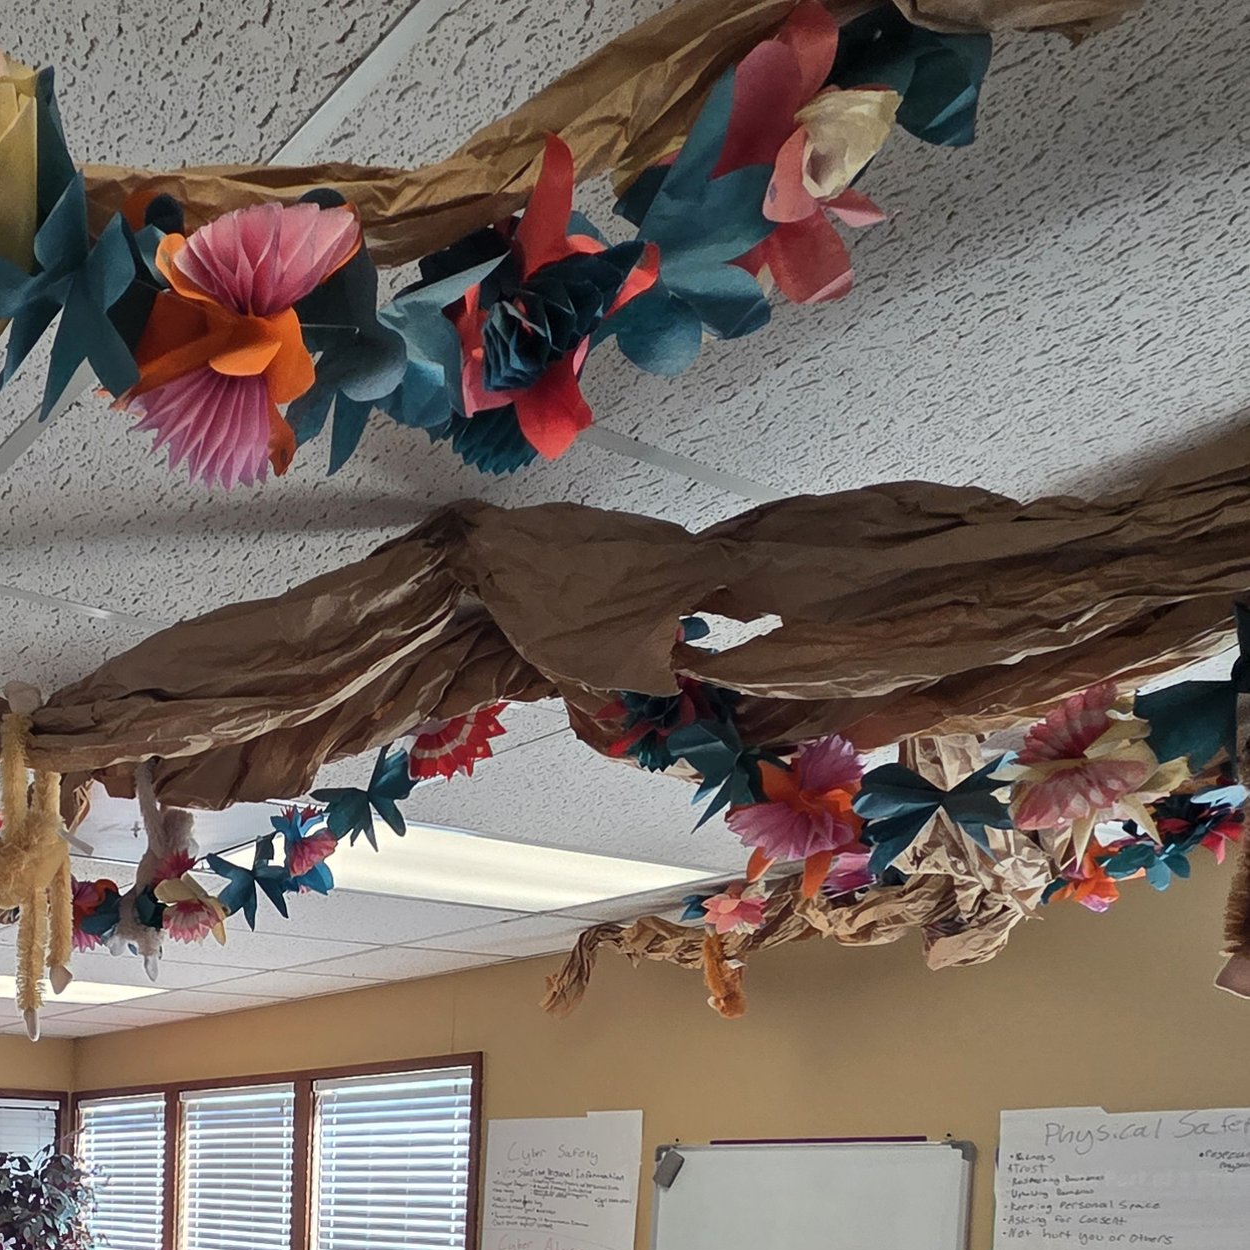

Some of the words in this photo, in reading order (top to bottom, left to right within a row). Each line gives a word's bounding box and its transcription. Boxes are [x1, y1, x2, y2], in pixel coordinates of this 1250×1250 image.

[1045, 1117, 1162, 1155] Physical
[557, 1143, 600, 1167] Safety
[1007, 1214, 1047, 1228] Asking
[1007, 1227, 1032, 1238] Not
[1042, 1227, 1072, 1240] hurt
[1078, 1232, 1103, 1246] you
[1108, 1231, 1125, 1243] or
